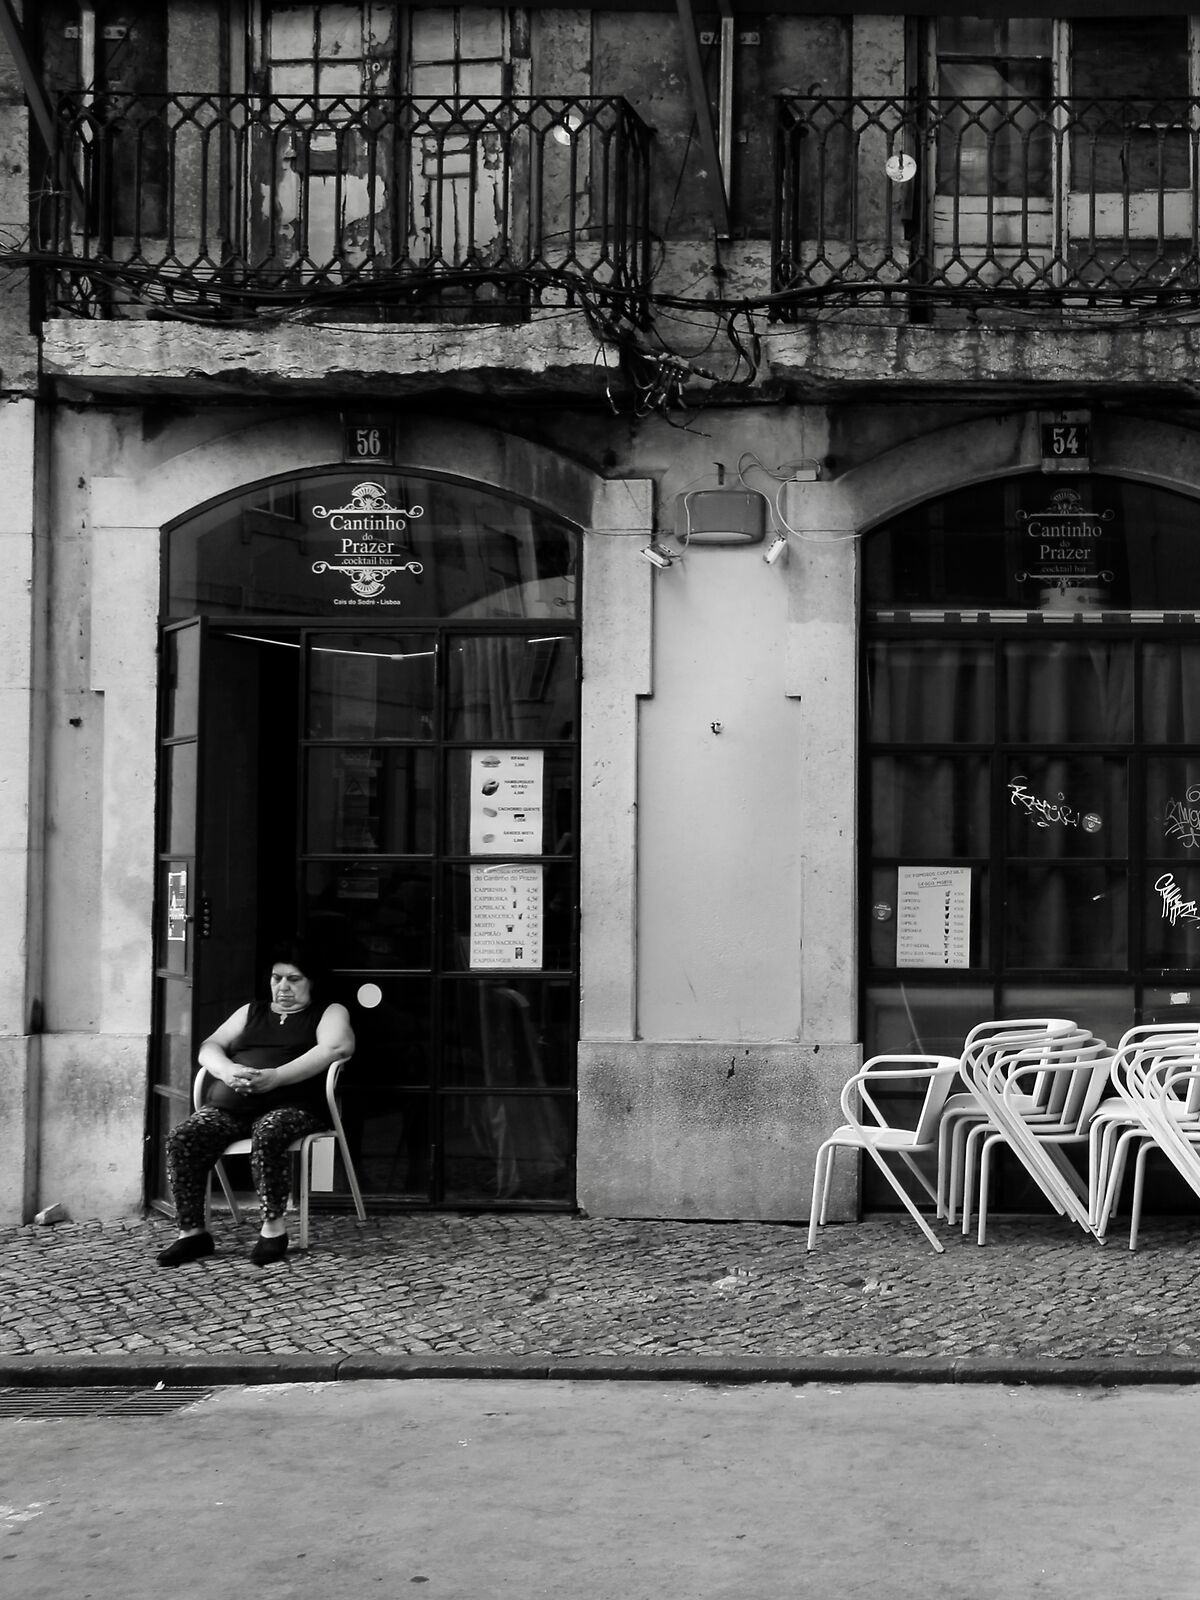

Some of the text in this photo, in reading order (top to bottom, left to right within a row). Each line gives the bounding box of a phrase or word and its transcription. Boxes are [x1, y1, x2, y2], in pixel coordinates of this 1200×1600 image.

[356, 429, 381, 456] 56
[1053, 427, 1079, 454] 54
[330, 515, 406, 531] Cantinho
[1028, 522, 1102, 537] Cantinho
[362, 533, 373, 541] do
[1059, 540, 1070, 548] do
[342, 538, 395, 554] Prazer
[1040, 545, 1091, 560] Prazer
[379, 556, 393, 565] bar
[1074, 564, 1087, 573] bar
